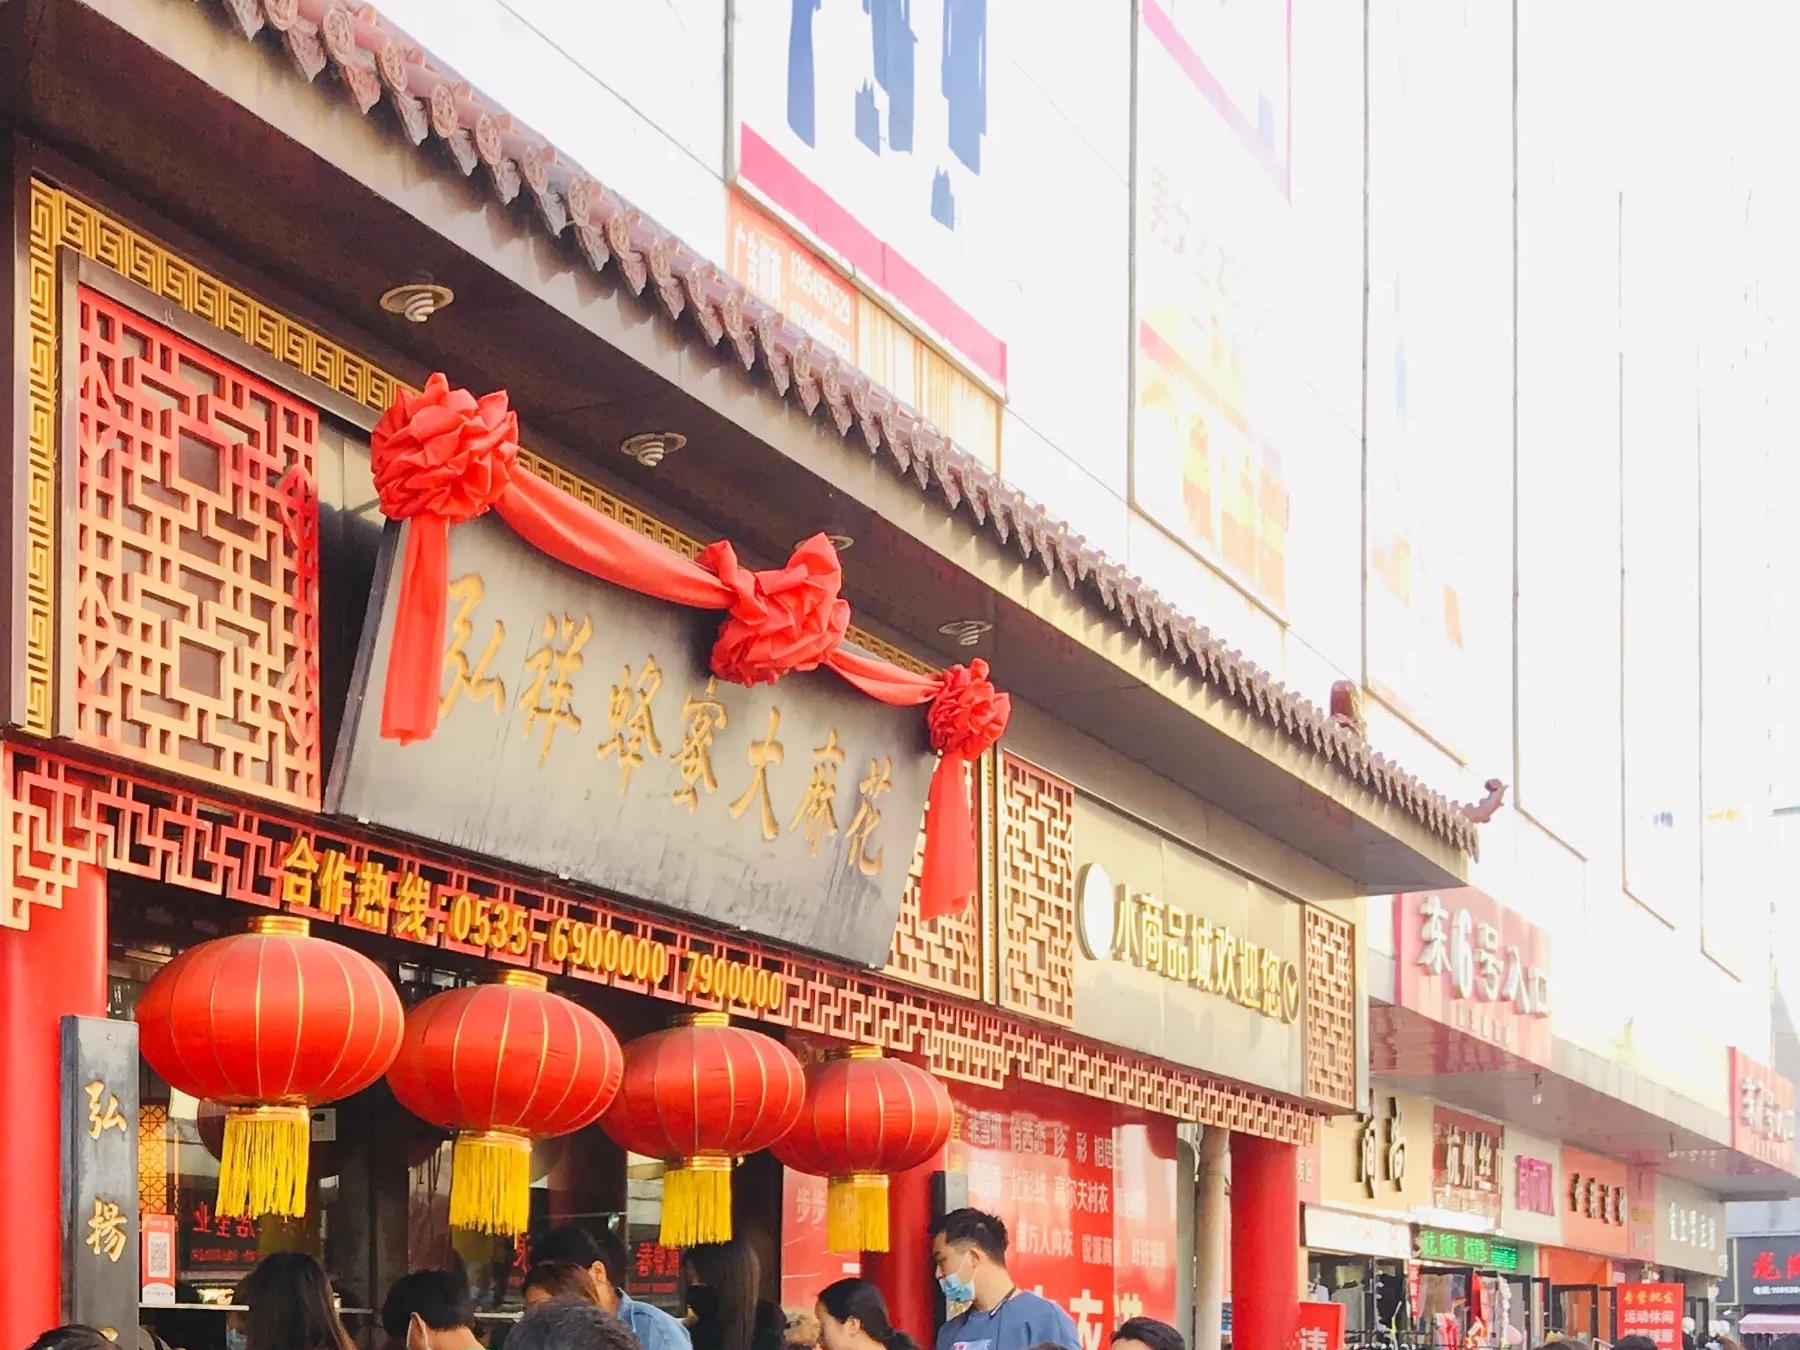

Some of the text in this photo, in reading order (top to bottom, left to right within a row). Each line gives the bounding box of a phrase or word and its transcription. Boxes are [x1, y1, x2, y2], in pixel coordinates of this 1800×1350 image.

[440, 574, 893, 876] 弘祥蜂蜜大麻花
[686, 951, 783, 1010] 7900000
[1417, 896, 1551, 1018] 东6号入口
